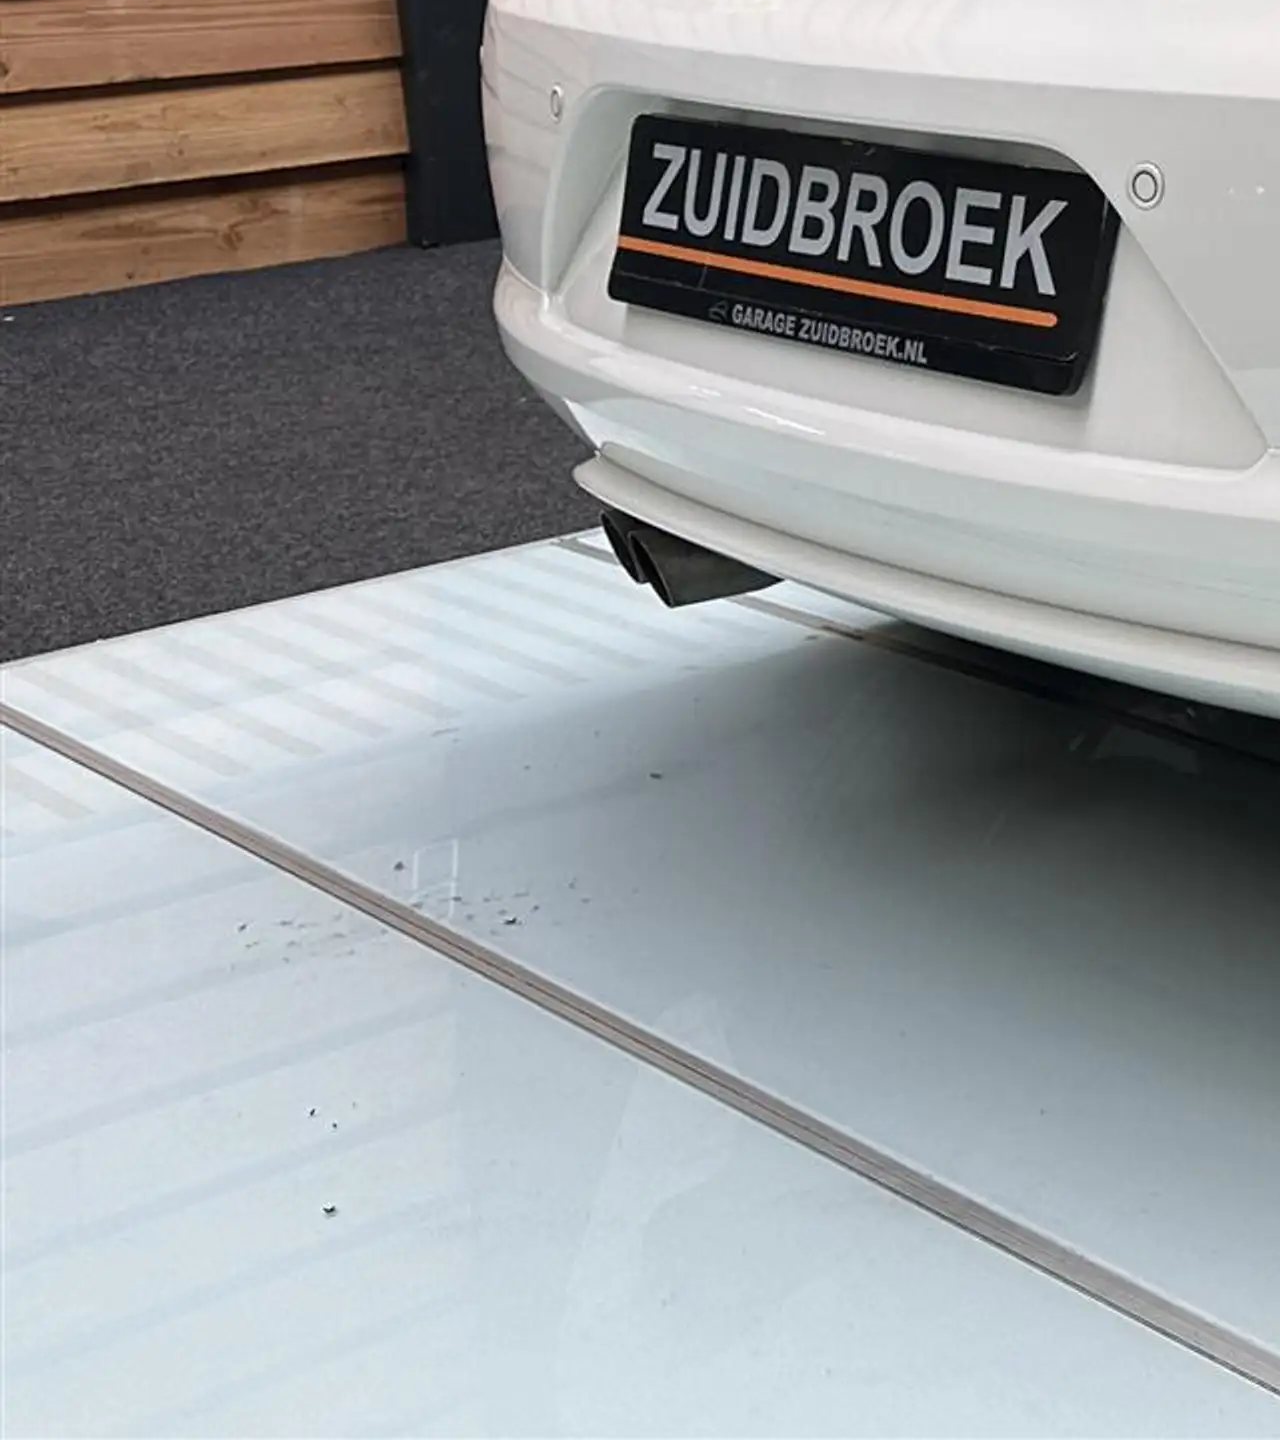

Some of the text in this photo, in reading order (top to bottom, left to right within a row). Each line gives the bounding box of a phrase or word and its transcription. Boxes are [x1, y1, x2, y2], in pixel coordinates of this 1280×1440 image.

[642, 143, 1068, 296] ZUIDBROEK
[732, 304, 928, 363] GARAGE ZUIDBROEK.NL
